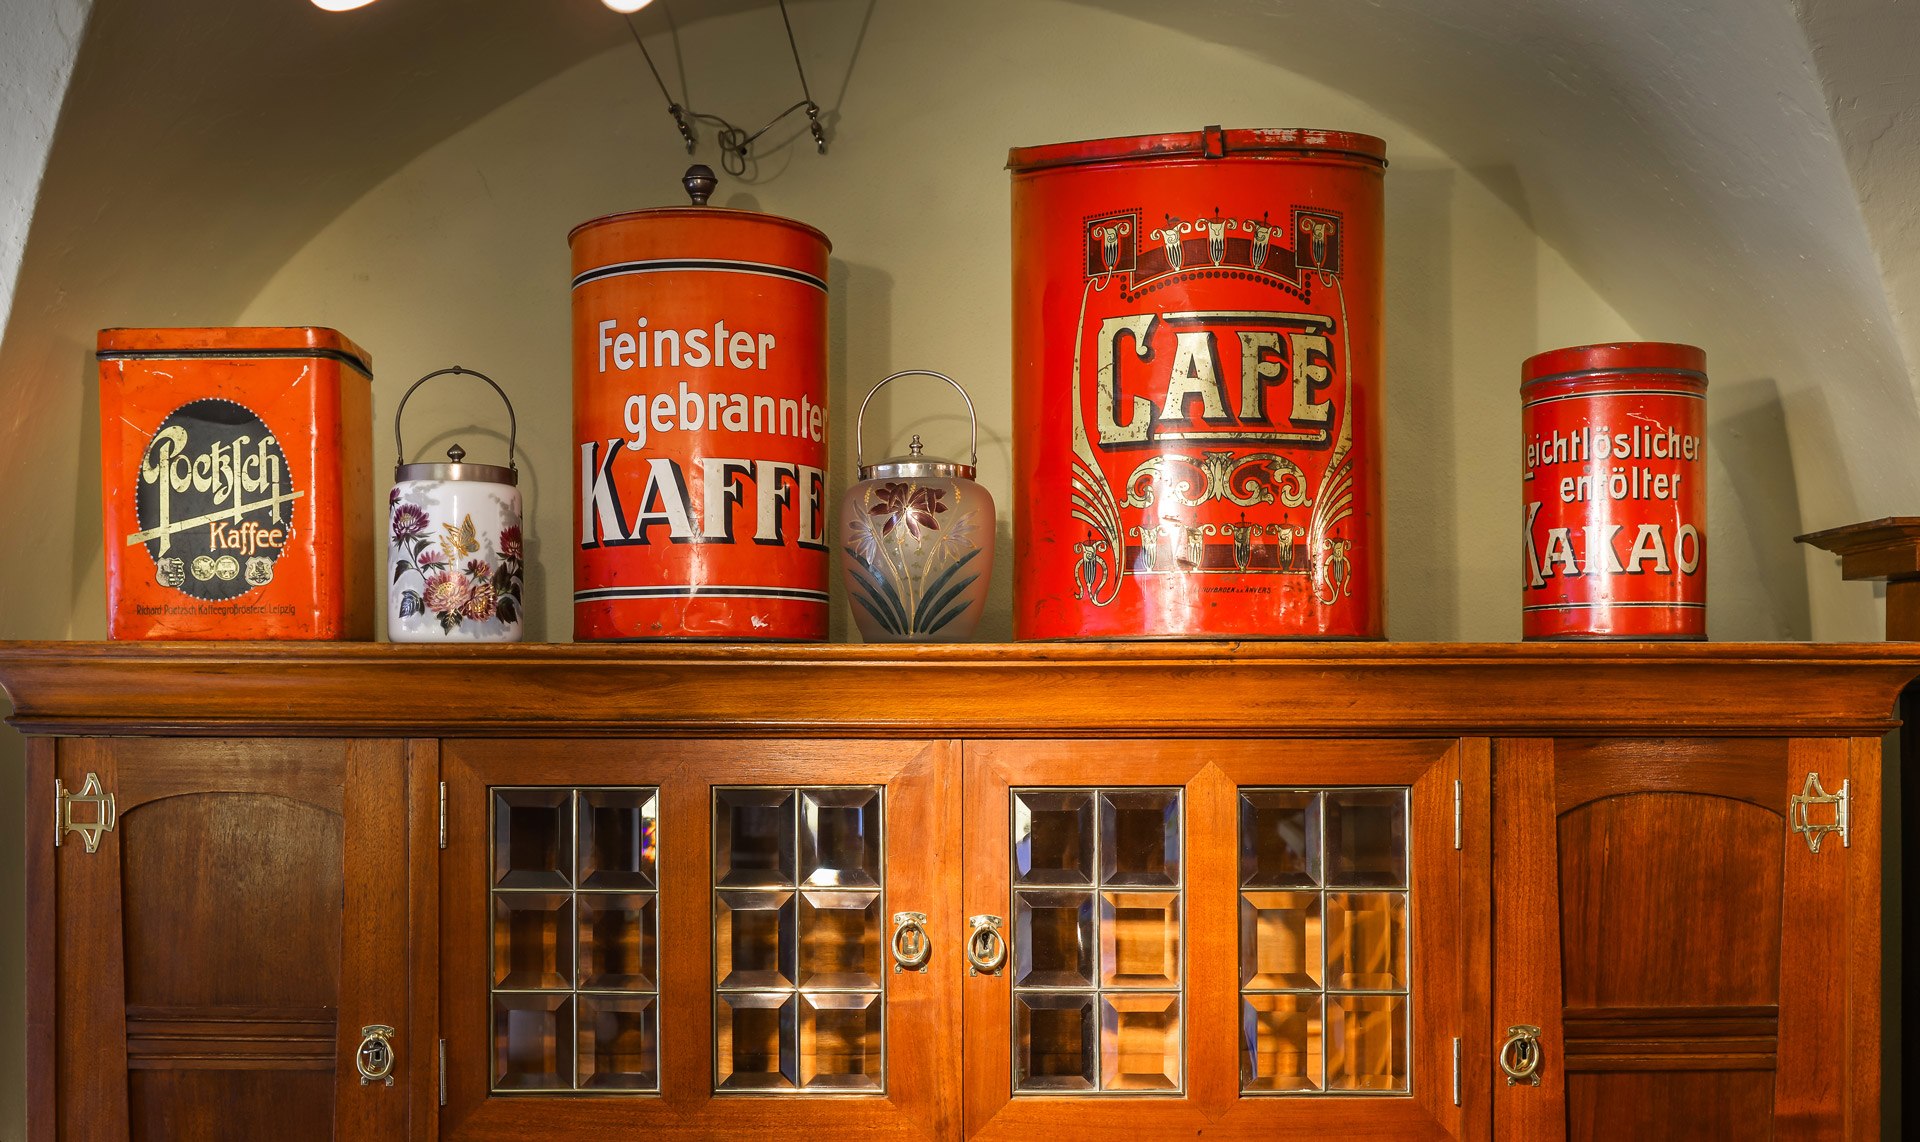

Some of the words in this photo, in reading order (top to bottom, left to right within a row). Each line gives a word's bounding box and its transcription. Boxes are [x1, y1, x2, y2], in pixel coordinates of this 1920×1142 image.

[598, 316, 776, 373] Feinster
[1097, 313, 1337, 447] CAFÉ
[623, 381, 829, 451] gebrannter
[1523, 425, 1701, 480] Leichtlöslicher
[580, 438, 830, 550] KAFFE
[209, 521, 284, 555] Kaffee
[1522, 501, 1700, 590] KAKAO
[136, 604, 162, 617] Richard
[268, 604, 296, 617] Leipzig
